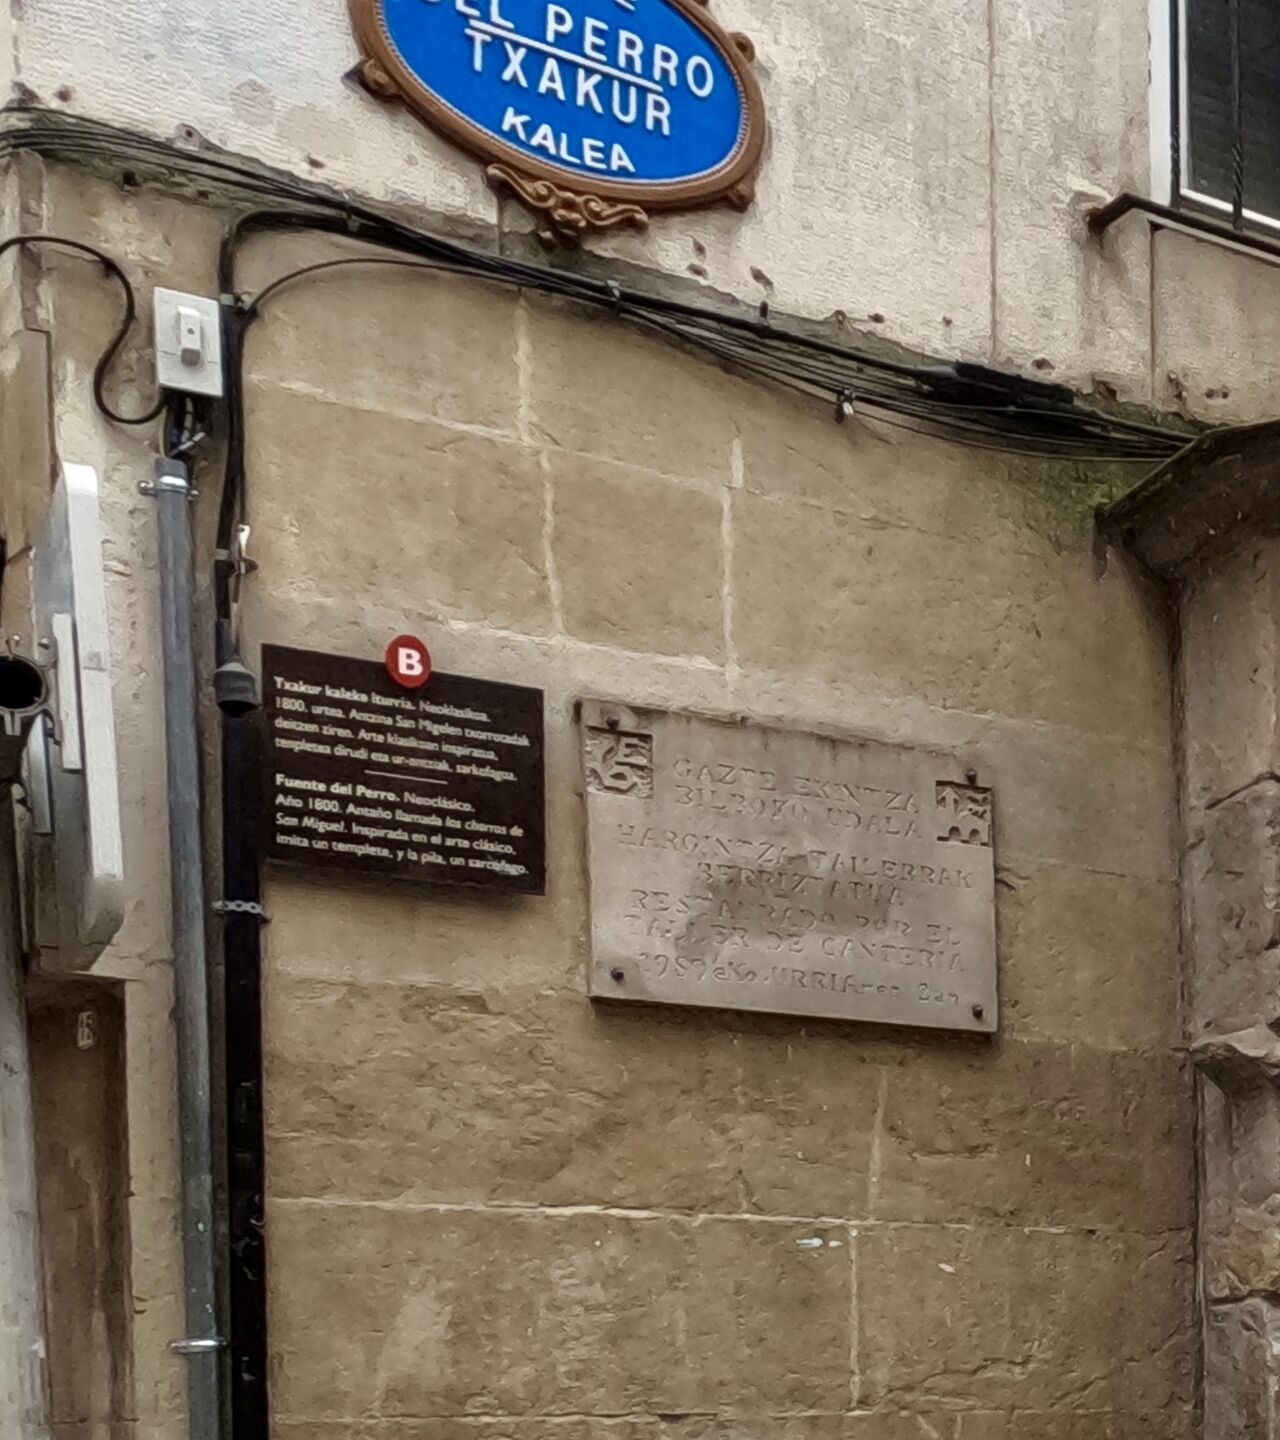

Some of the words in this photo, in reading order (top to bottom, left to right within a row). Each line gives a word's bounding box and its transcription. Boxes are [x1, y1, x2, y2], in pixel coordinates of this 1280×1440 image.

[546, 3, 714, 98] PERRO
[464, 27, 672, 136] TXAKUR
[501, 106, 636, 173] KALEA
[398, 647, 424, 676] B
[273, 675, 322, 695] Txakur
[276, 773, 327, 792] Fuente
[330, 781, 352, 796] del
[356, 784, 400, 802] Perro.
[673, 757, 776, 791] GAZTE
[275, 793, 303, 808] Año
[308, 797, 342, 814] 1800.
[509, 824, 524, 837] de
[275, 811, 299, 826] San
[302, 816, 348, 834] Miguel.
[352, 821, 410, 841] Inspirada
[411, 833, 428, 844] en
[826, 807, 923, 840] UDALA
[276, 832, 310, 848] imita
[312, 839, 328, 850] un
[396, 850, 404, 862] y
[407, 848, 418, 861] la
[766, 931, 805, 952] DE
[925, 924, 962, 947] EL
